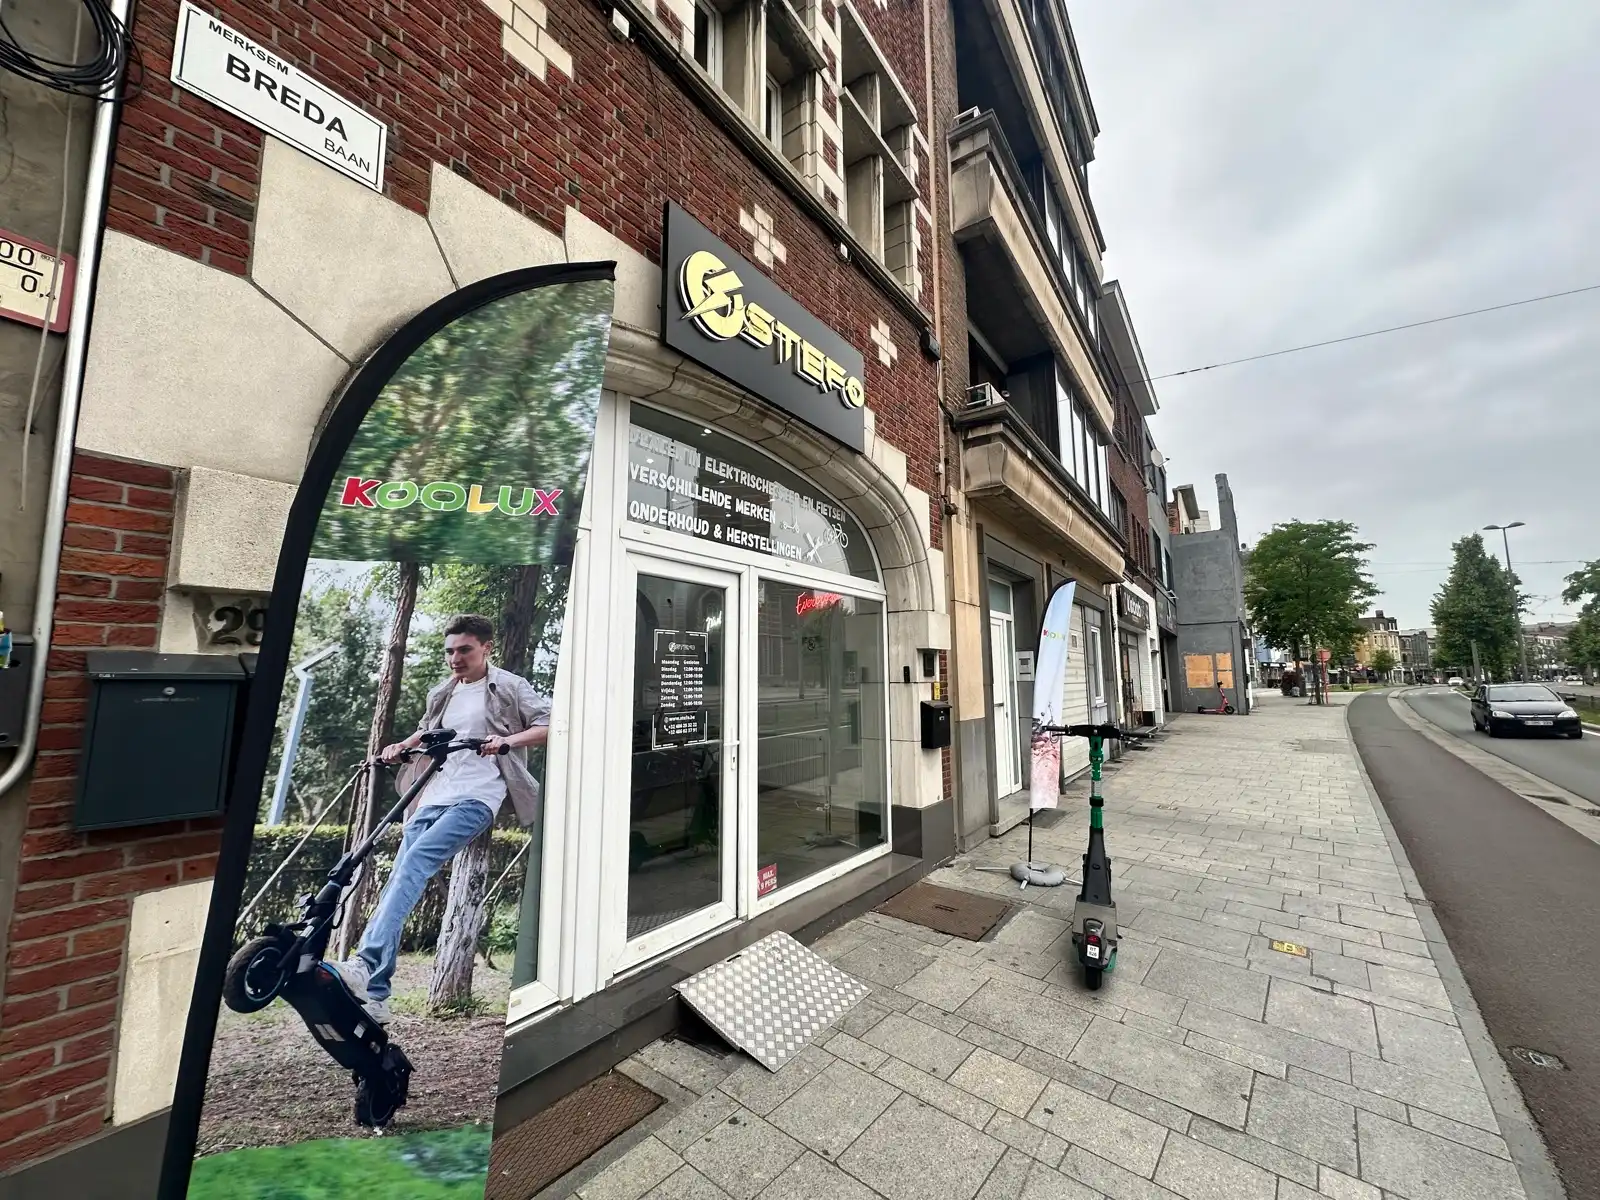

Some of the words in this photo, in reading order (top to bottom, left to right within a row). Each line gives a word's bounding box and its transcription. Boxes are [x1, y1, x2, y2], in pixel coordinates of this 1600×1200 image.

[208, 20, 290, 77] MERKSEM
[226, 53, 349, 142] BREDA
[323, 136, 372, 174] BAAN
[341, 476, 562, 516] KOOLUX
[629, 461, 732, 510] VERSCHILLENDE
[735, 498, 776, 524] MERKEN
[704, 456, 775, 496] ELEKTRISCHE
[815, 501, 847, 524] FIETSEN
[629, 500, 709, 536] ONDERHOUD
[714, 522, 722, 540] &
[726, 526, 802, 561] HERSTELLINGEN
